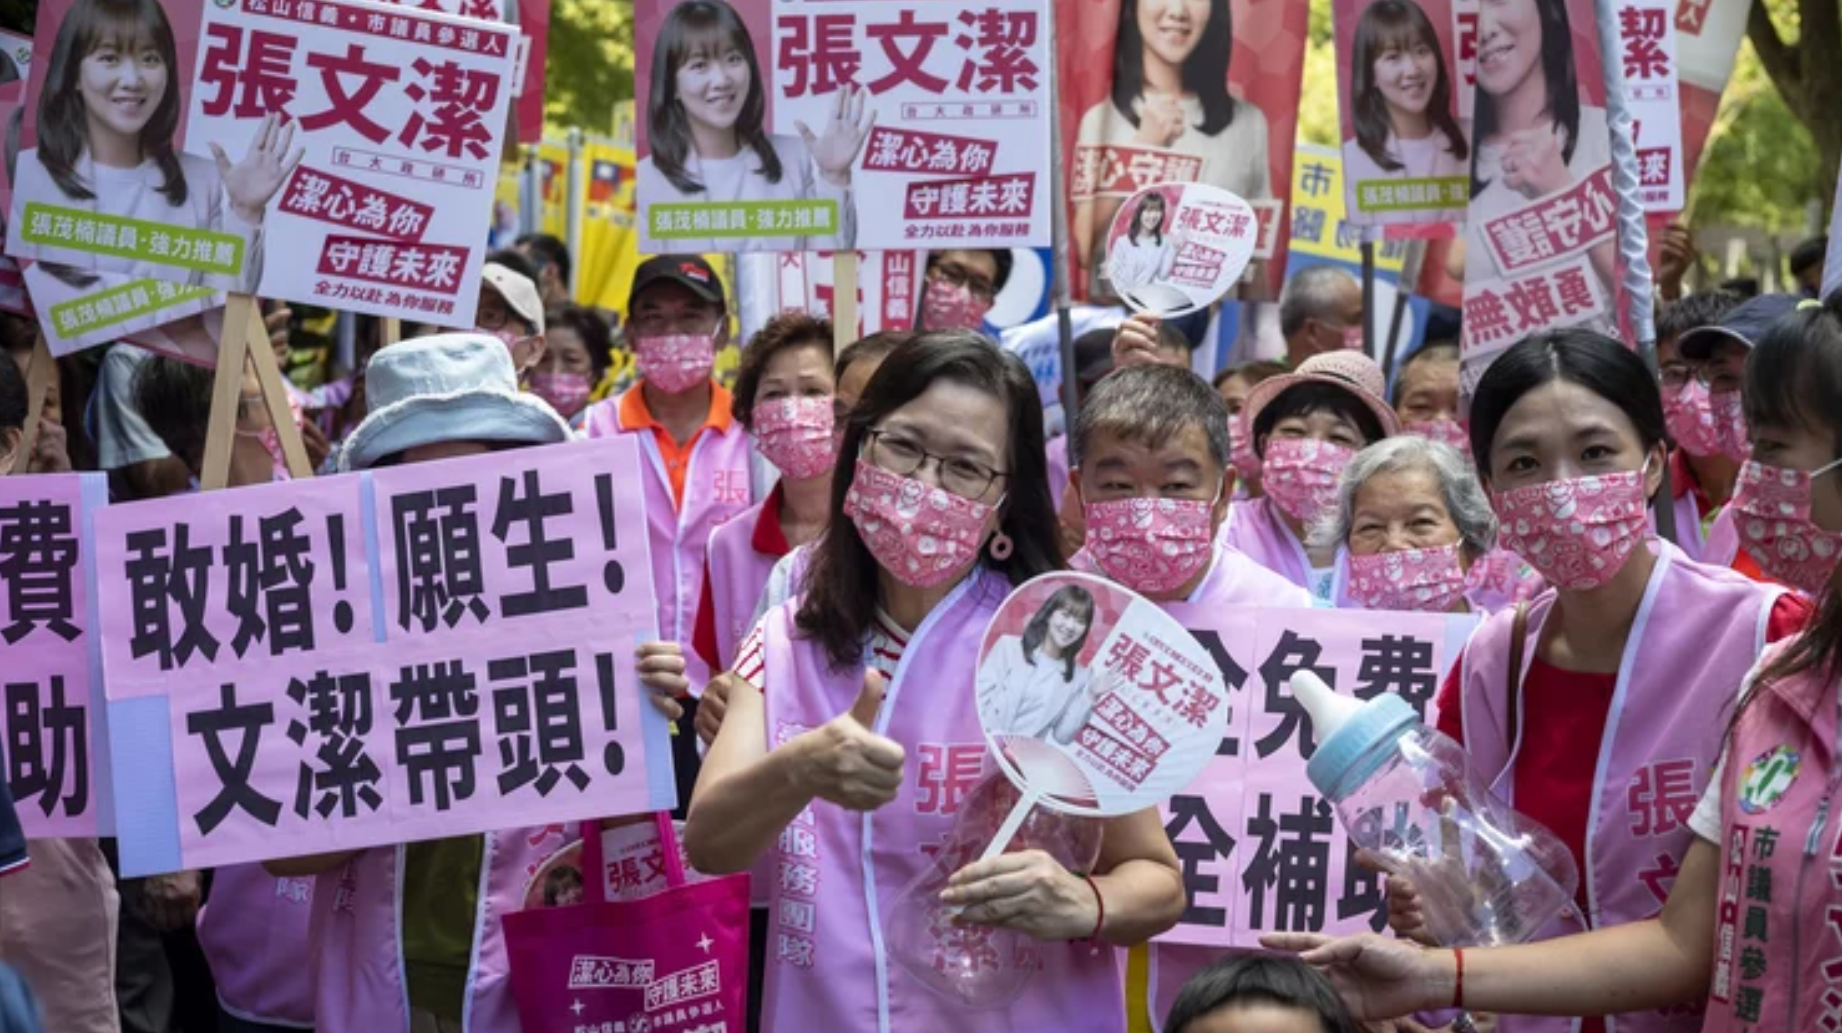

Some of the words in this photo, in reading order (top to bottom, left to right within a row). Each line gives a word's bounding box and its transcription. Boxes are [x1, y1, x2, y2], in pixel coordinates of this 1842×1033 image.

[777, 8, 1039, 97] 張文潔
[200, 22, 501, 160] 張文潔
[868, 131, 990, 172] 潔心為你
[1640, 151, 1668, 182] 來
[287, 173, 425, 235] 潔心為你
[909, 178, 1030, 214] 守護未來
[1177, 206, 1250, 238] 張文潔
[327, 241, 461, 288] 守護未來
[1104, 632, 1220, 728] 張文潔
[5, 675, 90, 818] 助
[187, 648, 625, 836] 文潔帶頭！
[1734, 825, 1780, 1033] 市議員參選
